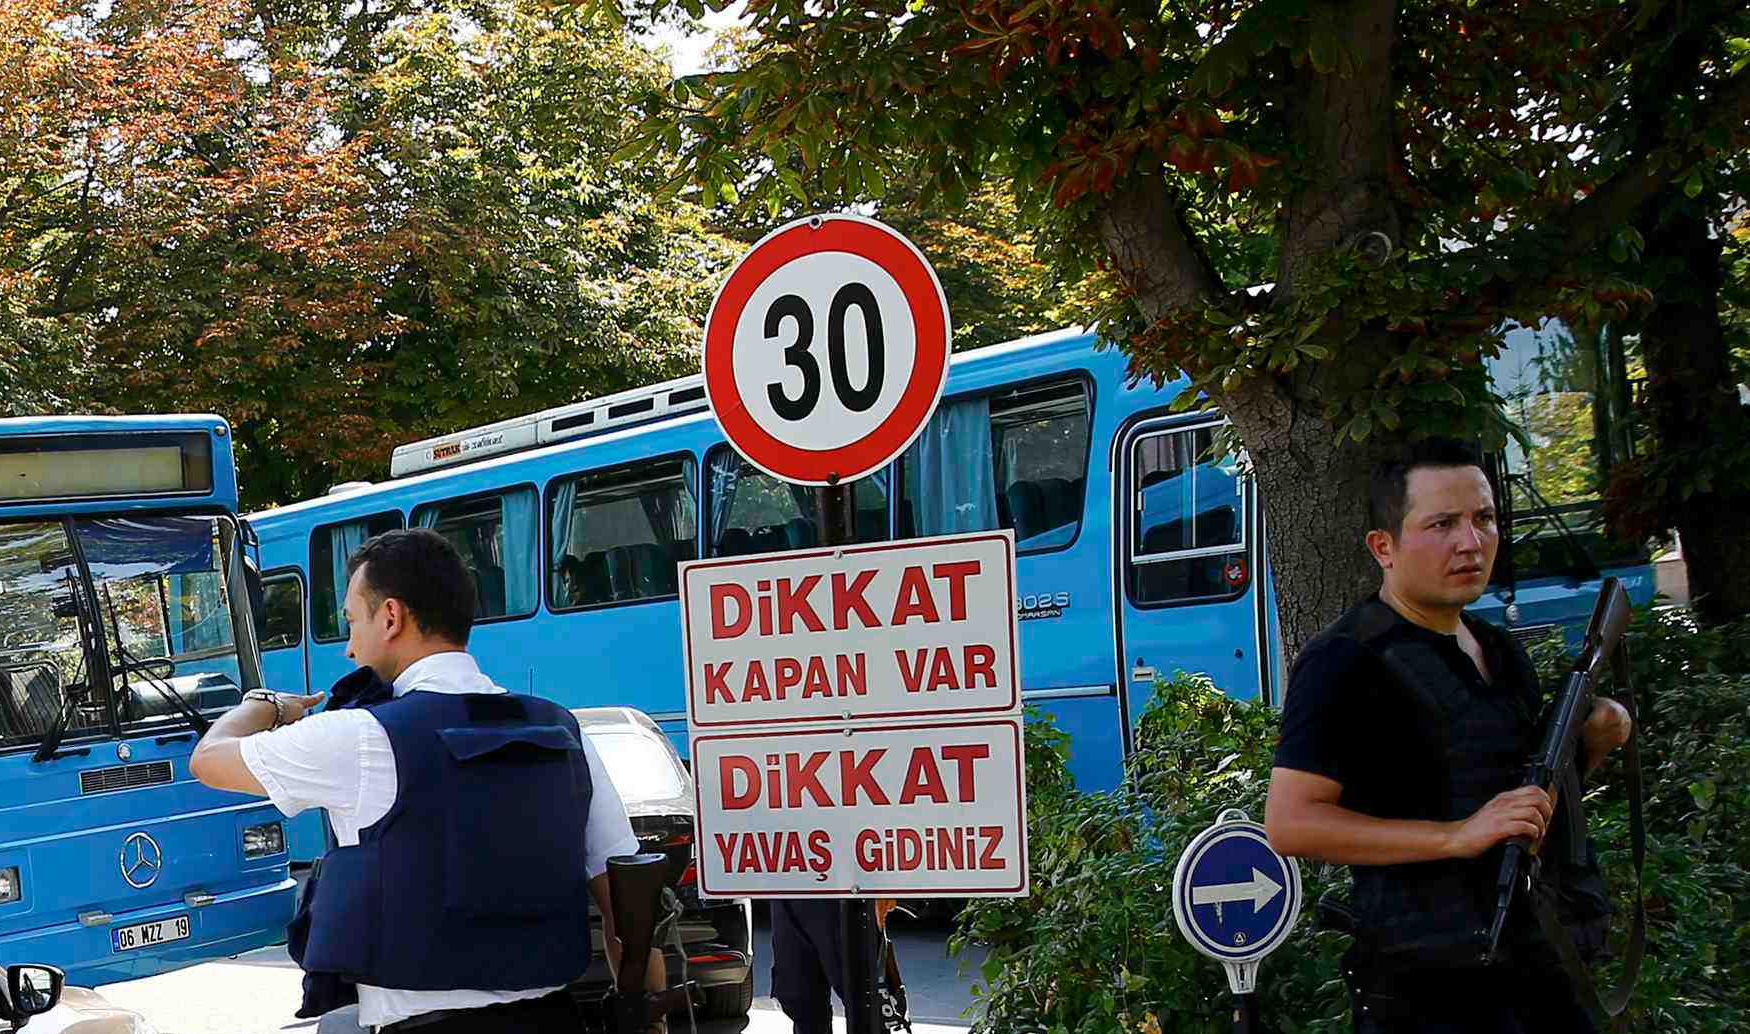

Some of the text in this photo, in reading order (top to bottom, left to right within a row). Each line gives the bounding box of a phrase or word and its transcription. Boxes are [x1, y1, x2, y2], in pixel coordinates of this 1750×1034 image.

[763, 282, 885, 421] 30
[704, 644, 998, 705] KAPAN VAR
[714, 829, 833, 882] YAVAŞ
[119, 918, 187, 948] 06 MZZ 19
